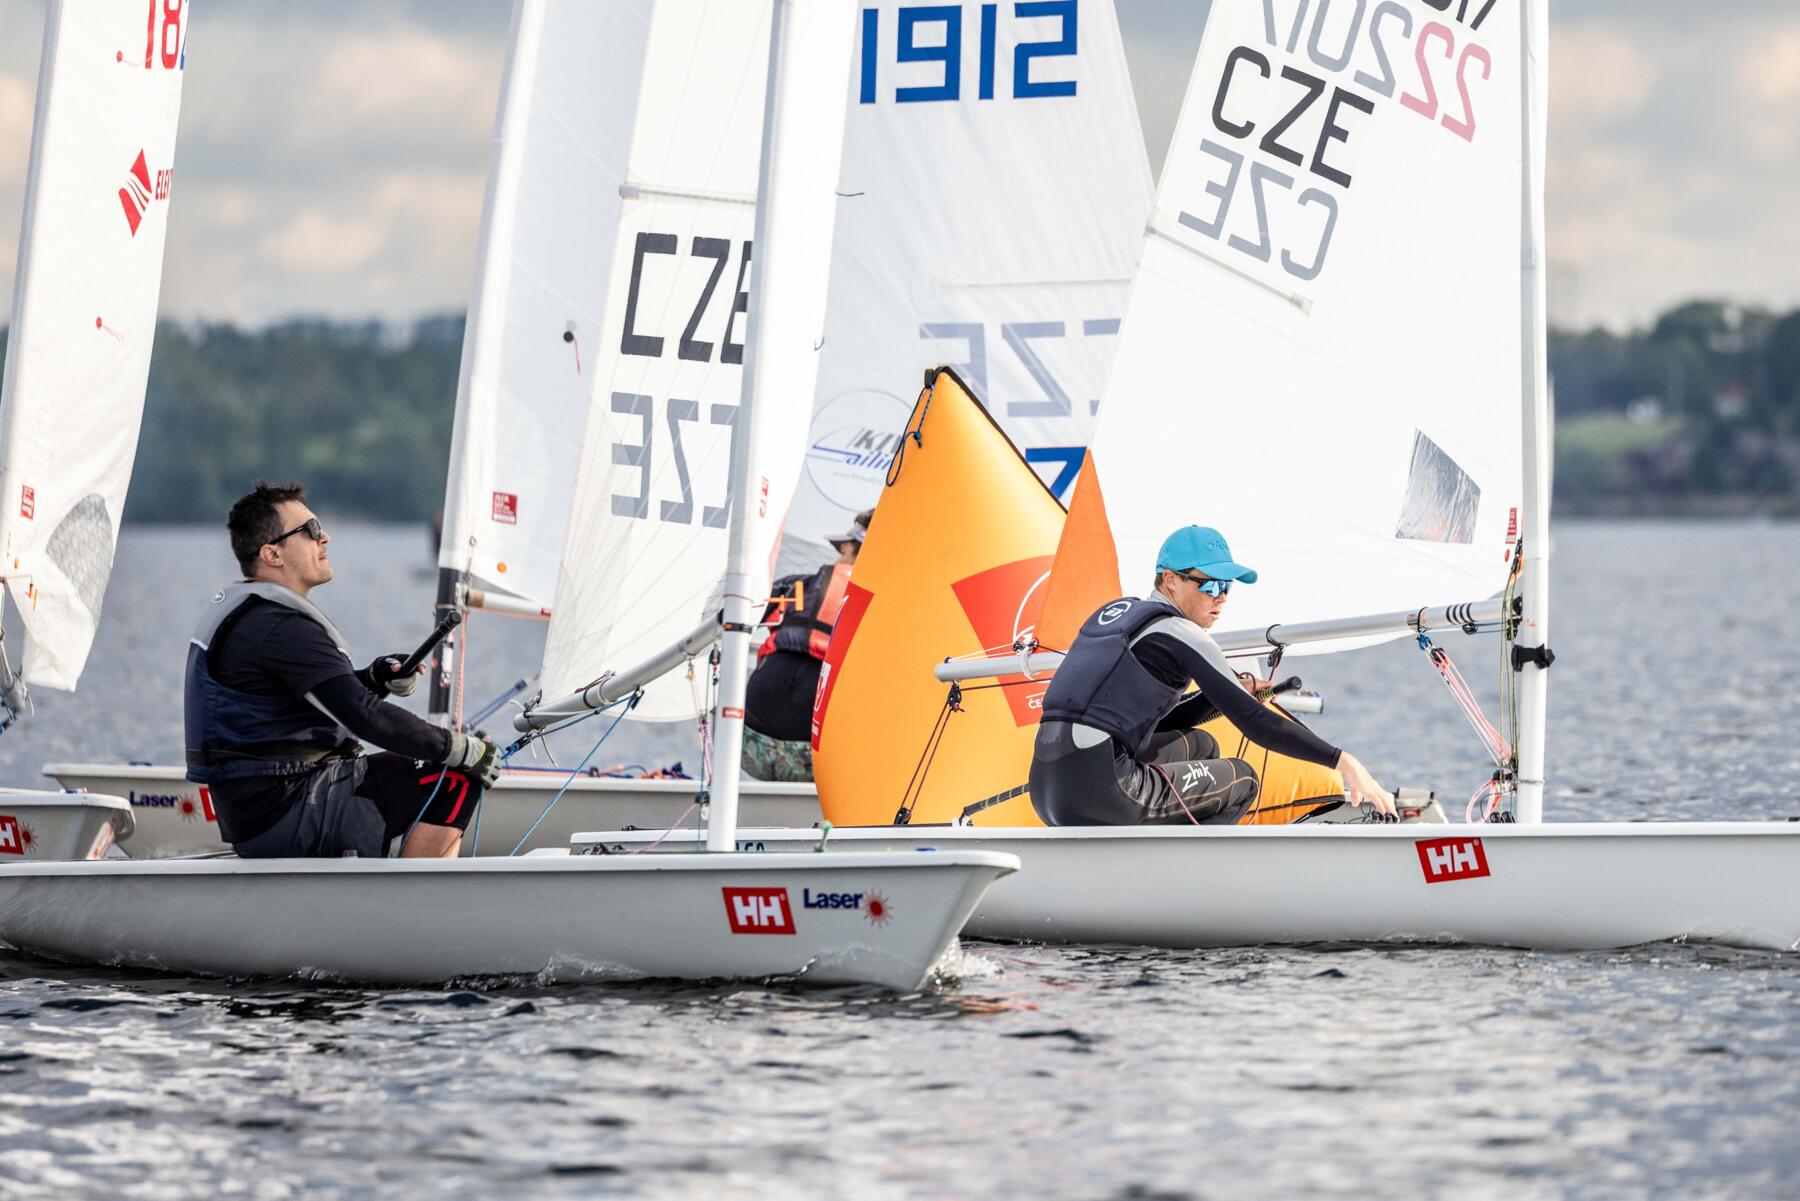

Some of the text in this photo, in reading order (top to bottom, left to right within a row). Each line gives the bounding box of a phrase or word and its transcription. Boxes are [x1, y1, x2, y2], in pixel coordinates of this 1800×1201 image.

[860, 0, 1077, 104] 1912
[1212, 46, 1375, 189] CZE
[130, 791, 178, 807] Laser
[1426, 842, 1479, 875] HH
[732, 895, 785, 926] HH
[803, 888, 863, 909] Laser
